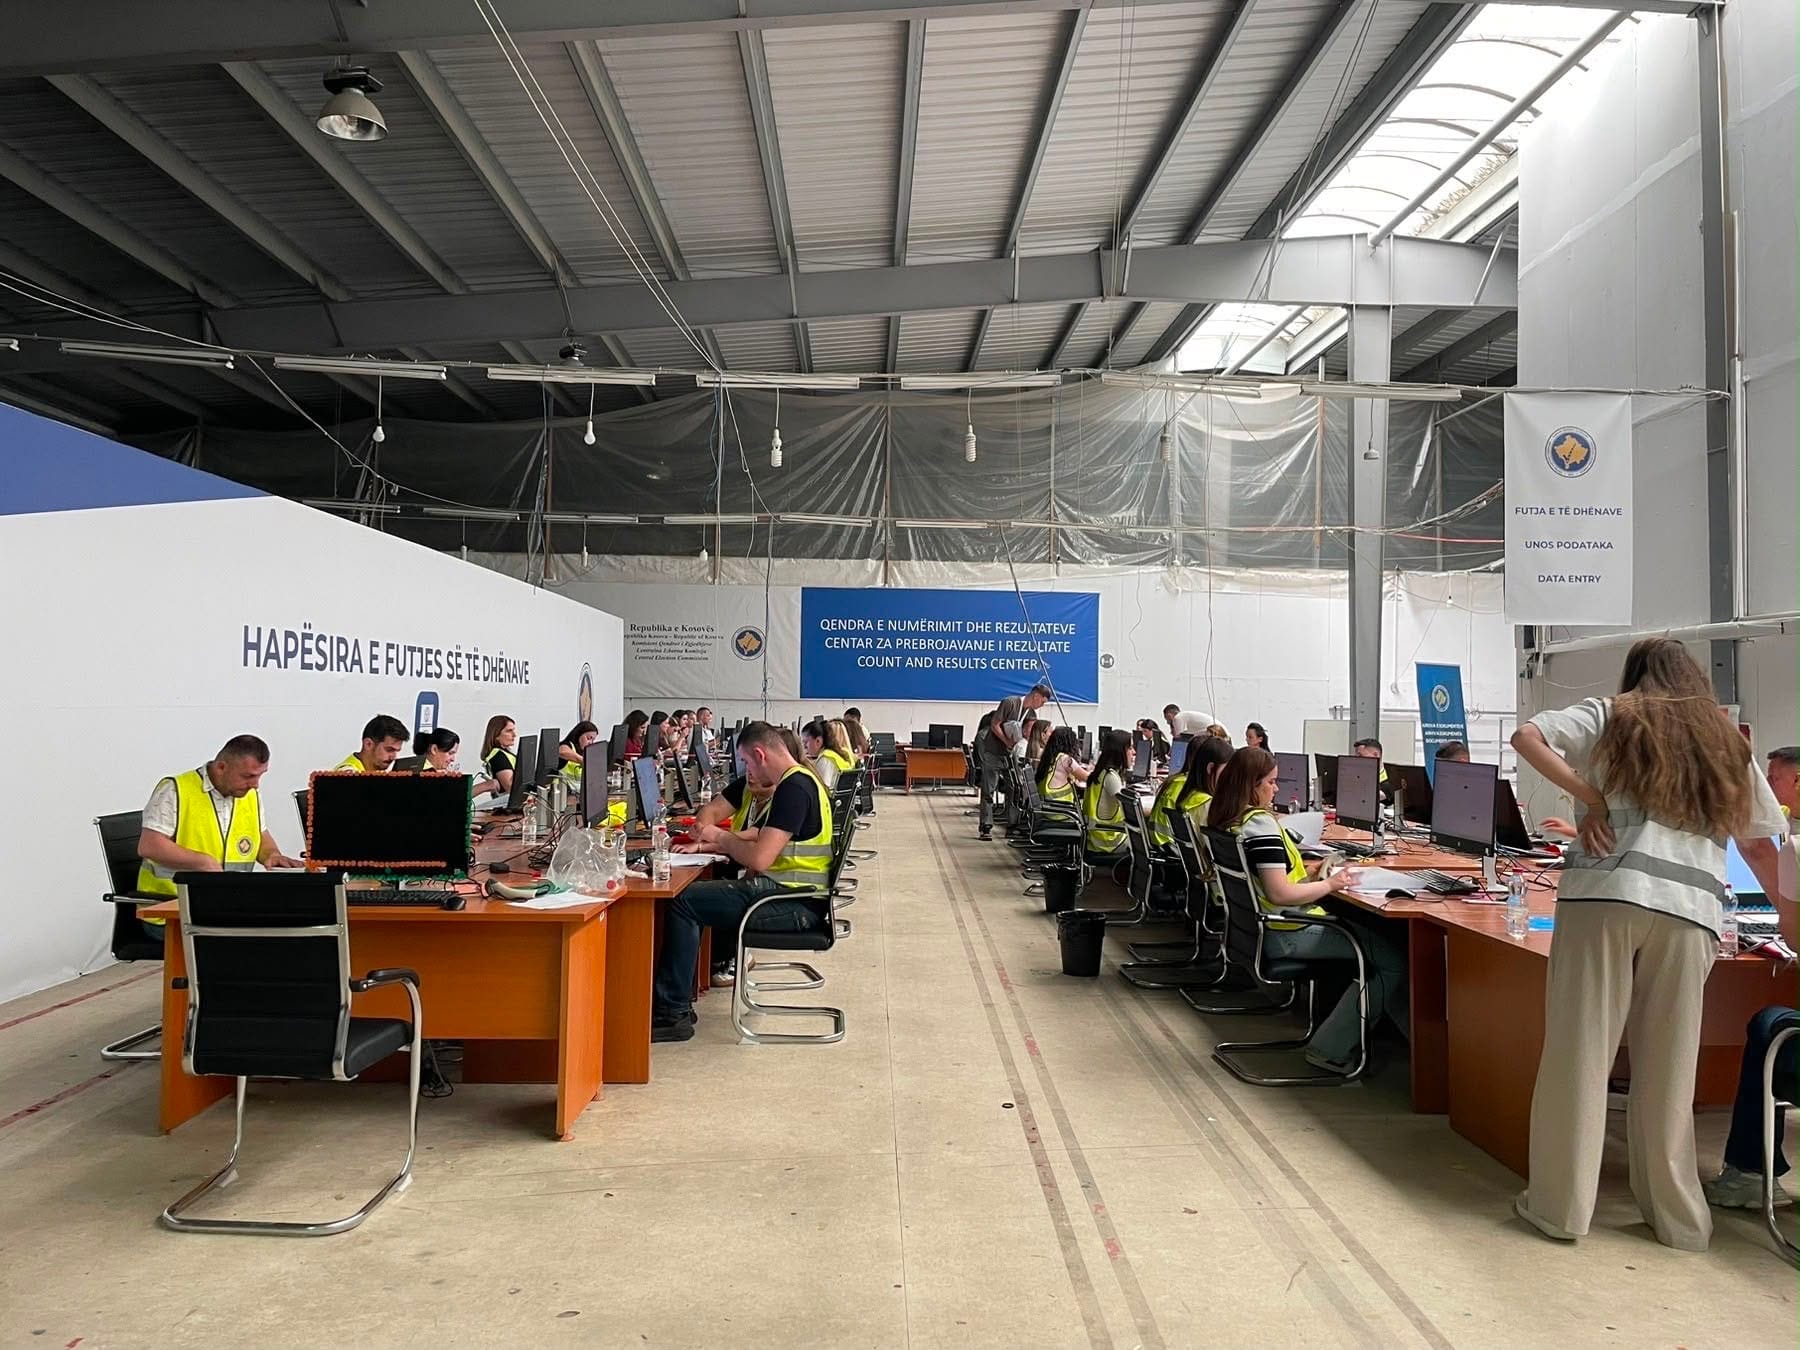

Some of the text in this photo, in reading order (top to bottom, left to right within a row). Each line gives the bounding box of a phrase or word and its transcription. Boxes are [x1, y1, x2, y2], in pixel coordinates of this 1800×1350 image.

[1515, 505, 1623, 516] FUTJA E TË DHËNAVE
[1525, 540, 1614, 550] UNOS PODATAKA
[1538, 574, 1602, 584] DATA ENTRY
[630, 624, 672, 633] Republika
[681, 624, 714, 632] Kosovës
[820, 618, 874, 632] QENDRA
[877, 619, 884, 631] E
[888, 617, 963, 632] NUMËRIMIT
[966, 621, 992, 633] DHE
[825, 637, 873, 649] CENTAR
[876, 637, 892, 649] ZA
[895, 638, 995, 651] PREBROJAVANJE
[1006, 640, 1071, 653] REZULTATE
[243, 622, 530, 685] HAPËSIRA E FUTJES SË TË DHËNAVE
[857, 655, 1038, 670] COUNT AND RESULTS CENTER
